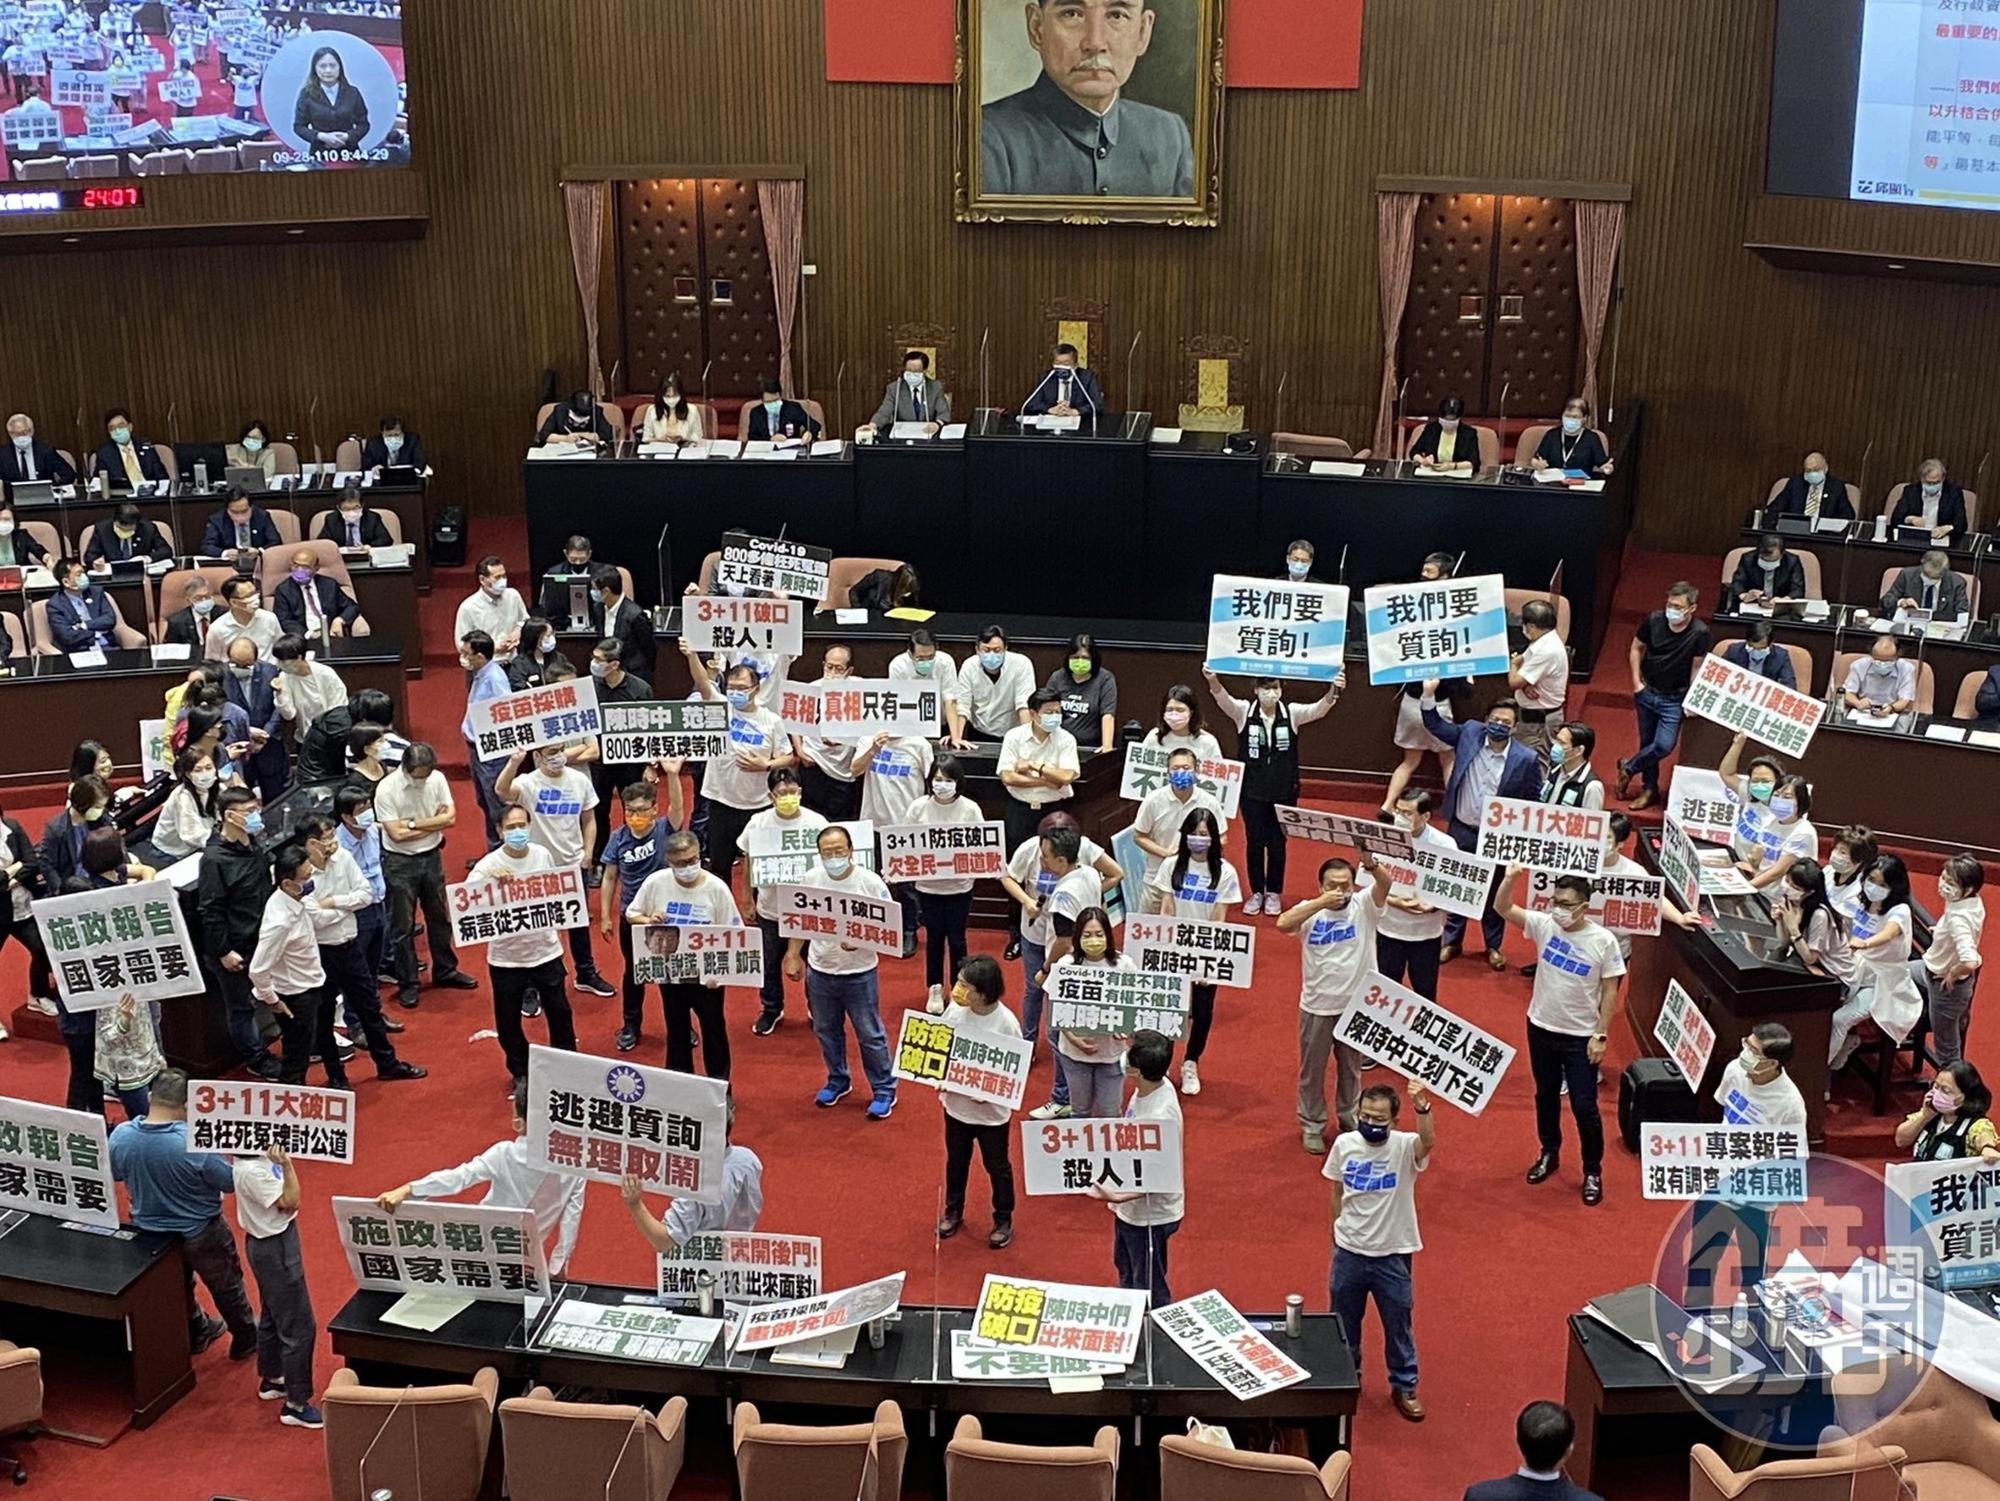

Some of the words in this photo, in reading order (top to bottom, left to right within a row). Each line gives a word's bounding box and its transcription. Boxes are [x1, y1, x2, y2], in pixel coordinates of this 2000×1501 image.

[272, 150, 338, 164] 09-28-110
[341, 148, 389, 163] 9:44:29
[84, 188, 137, 208] 24:07
[749, 538, 807, 557] Covid-19
[722, 564, 775, 589] 天上看著
[697, 600, 789, 625] 3+11破口
[1232, 587, 1324, 622] 我們要
[1387, 586, 1480, 625] 我們要
[712, 626, 773, 650] 殺人！
[1237, 625, 1310, 659] 質詢!
[1397, 627, 1472, 661] 質詢!
[489, 686, 578, 726] 疫苗採購
[604, 707, 672, 731] 陳時中
[825, 691, 937, 723] 真相只有一個
[479, 724, 535, 754] 破黑箱
[542, 708, 599, 740] 要真相
[605, 735, 728, 761] 800多條冤魂等你!
[1487, 801, 1604, 842] 3+11大破口
[1682, 798, 1734, 827] 逃避
[886, 826, 1000, 850] 3+11防疫破口
[1483, 831, 1600, 874] 為枉死冤魂討公道
[888, 851, 1002, 876] 欠全民一個道歉
[454, 870, 578, 912] 3+11防疫破口
[794, 891, 886, 923] 3+11破口
[47, 901, 177, 952] 施政報告
[458, 899, 582, 941] 病毒從天而降?
[782, 912, 838, 935] 不調查
[846, 920, 898, 948] 沒真相
[688, 930, 746, 950] 3+11
[1131, 923, 1250, 954] 3+11就是破口
[61, 944, 190, 995] 國家需要
[1058, 966, 1105, 980] Covid-19
[1141, 949, 1235, 982] 陳時中下台
[1058, 977, 1104, 1001] 疫苗
[1052, 1002, 1124, 1032] 陳時中
[1364, 984, 1504, 1075] 3+11破口害人無數
[904, 1016, 955, 1053] 防疫
[899, 1044, 949, 1080] 破口
[952, 1035, 1022, 1075] 陳時中們
[1343, 1010, 1485, 1107] 陳時中立刻下台
[946, 1060, 1020, 1100] 出來面對!
[196, 1085, 348, 1124] 3+11大破口
[549, 1089, 703, 1151] 逃避質詢
[194, 1118, 348, 1160] 為枉死冤魂討公道
[1042, 1122, 1162, 1154] 3+11破口
[1649, 1131, 1799, 1161] 3+11專案報告
[548, 1129, 700, 1191] 無理取鬧
[1063, 1157, 1143, 1189] 殺人！
[1649, 1165, 1721, 1195] 沒有調查
[1729, 1167, 1802, 1197] 沒有真相
[349, 1216, 530, 1257] 施政報告
[358, 1252, 540, 1293] 國家需要
[985, 1282, 1046, 1316] 防疫
[1044, 1297, 1133, 1328] 陳時中們
[596, 1309, 683, 1335] 民進黨
[978, 1311, 1044, 1346] 破口
[1037, 1324, 1135, 1356] 出來面對!
[964, 1350, 1106, 1376] 不要臉
